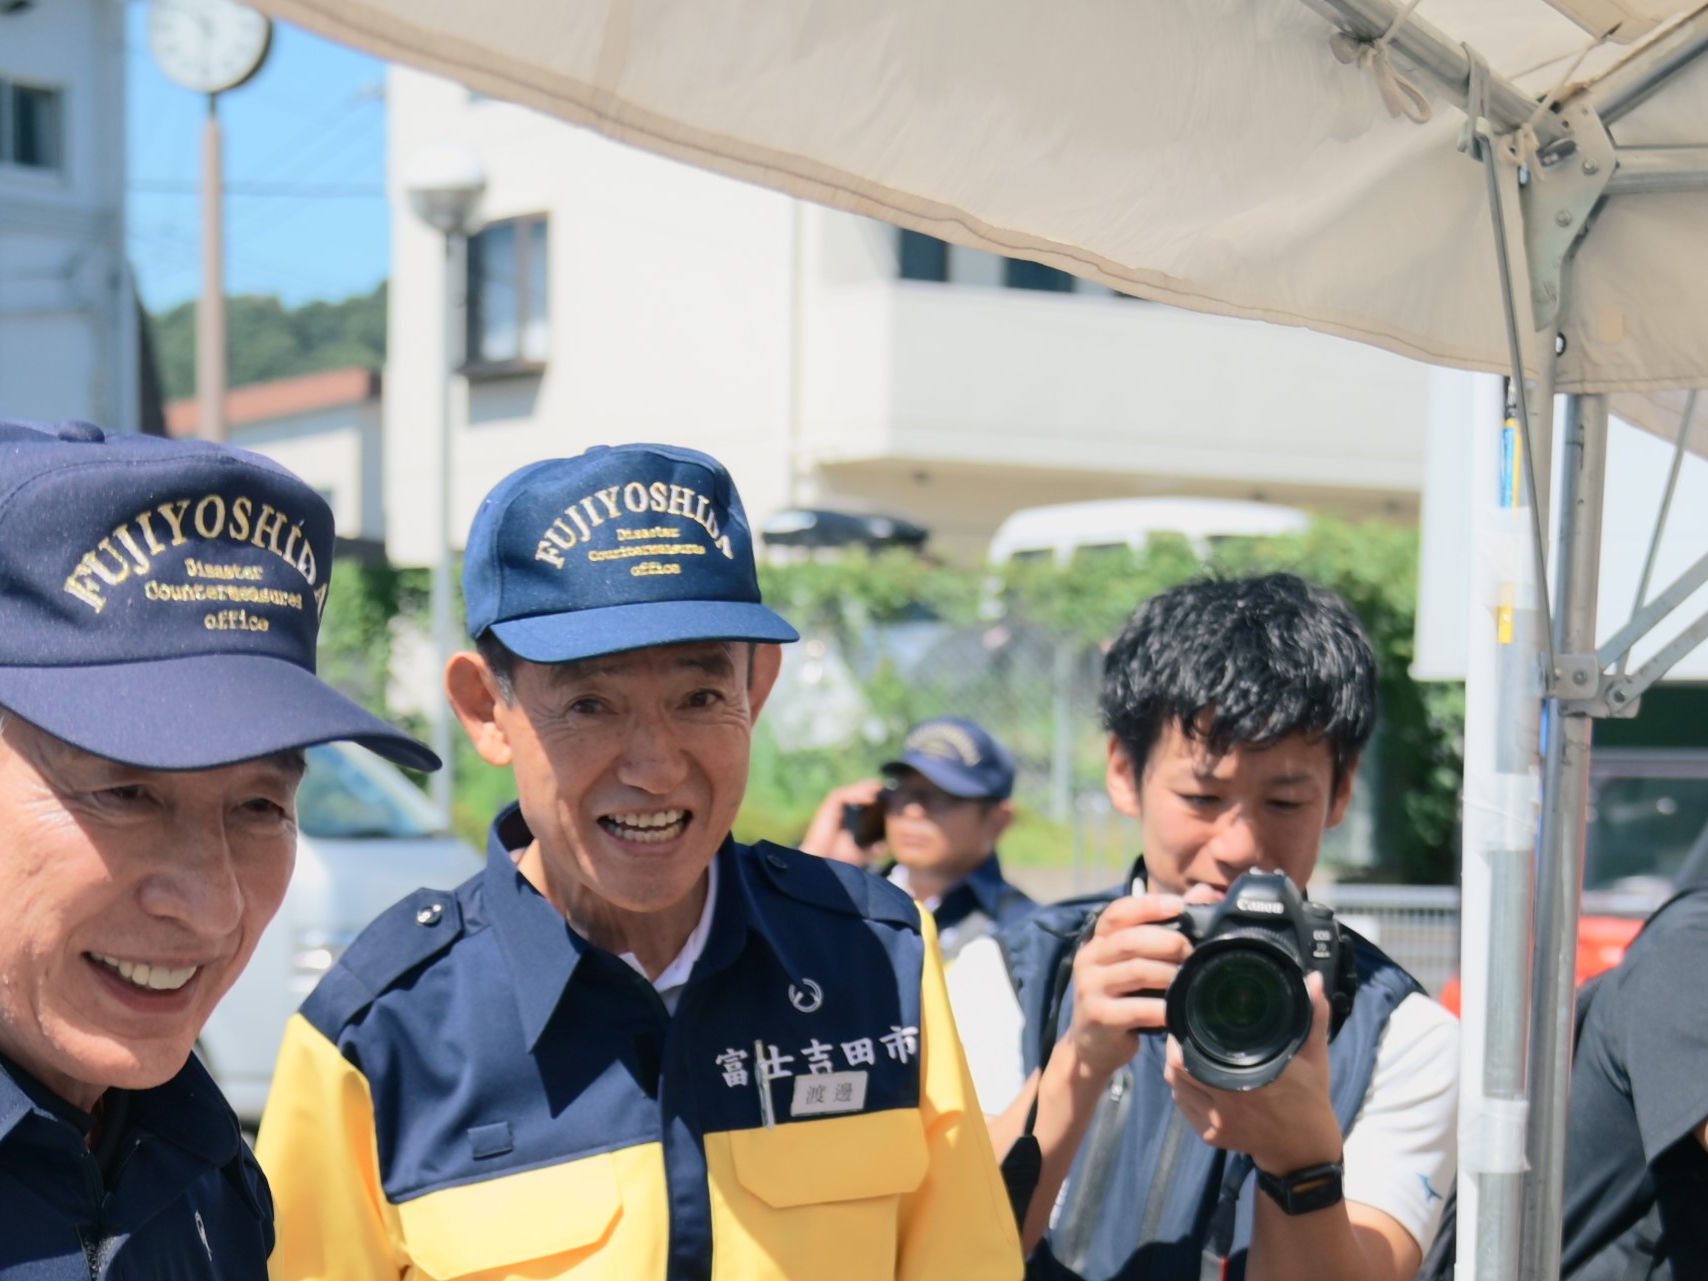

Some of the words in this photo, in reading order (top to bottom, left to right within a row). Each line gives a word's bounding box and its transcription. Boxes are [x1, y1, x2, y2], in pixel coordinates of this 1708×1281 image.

[535, 481, 734, 569] FUJIYOSHIDA
[185, 557, 264, 580] Disaster
[145, 580, 303, 610] Countermeasures
[204, 609, 270, 632] office
[1236, 898, 1285, 915] Canon
[715, 1026, 919, 1089] 富士吉田市
